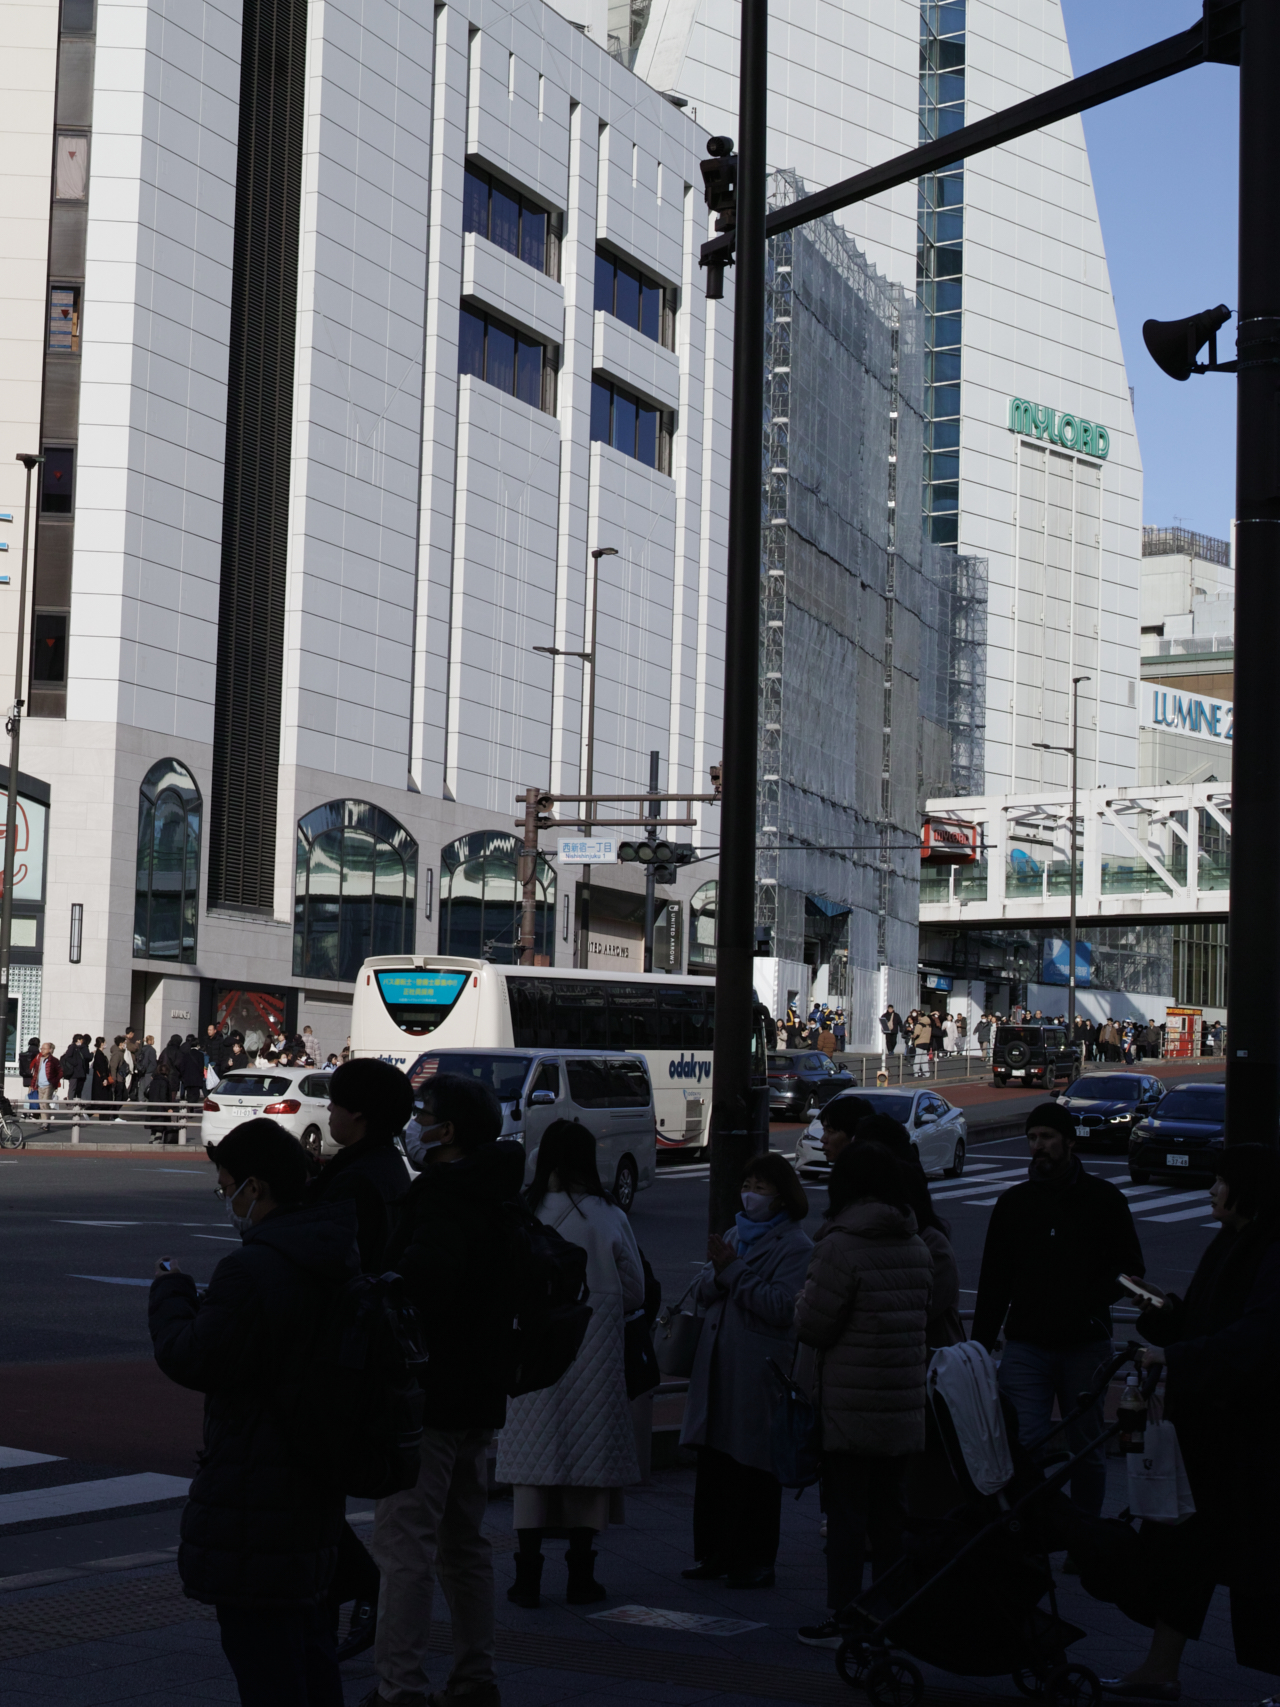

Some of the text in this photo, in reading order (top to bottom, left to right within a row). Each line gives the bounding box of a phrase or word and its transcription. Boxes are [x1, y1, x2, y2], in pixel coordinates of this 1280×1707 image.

[1007, 397, 1110, 459] MYLORD
[1152, 690, 1222, 737] LUMINE
[562, 842, 612, 853] 西新宿一丁目
[603, 943, 629, 958] ARROWS
[373, 1054, 406, 1066] dakyu
[669, 1052, 712, 1084] odakyu
